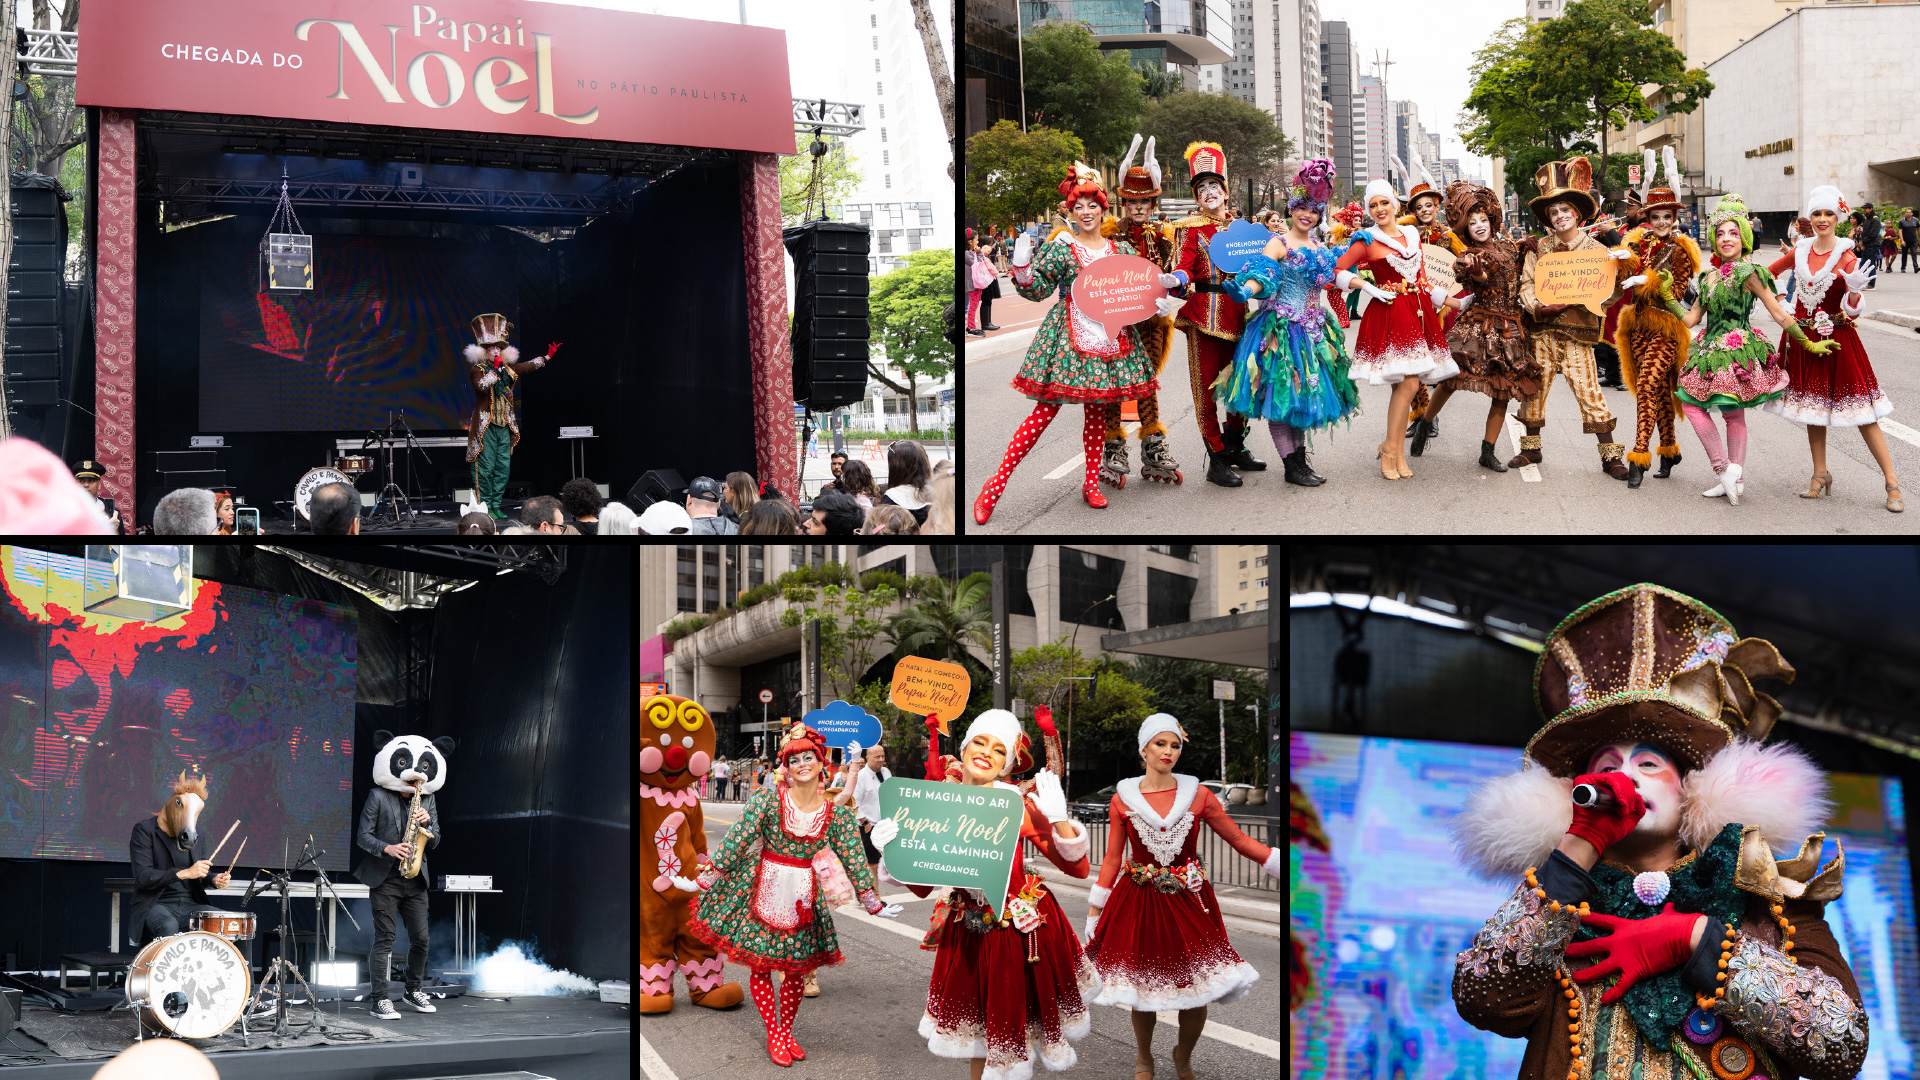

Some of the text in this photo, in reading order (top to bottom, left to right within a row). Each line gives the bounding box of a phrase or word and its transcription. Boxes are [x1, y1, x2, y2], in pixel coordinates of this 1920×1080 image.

[412, 4, 525, 52] Papai
[161, 44, 303, 69] CHEGADA DO
[577, 79, 748, 102] NO PÁTIO PAULISTA
[1226, 240, 1266, 248] #NOELNOPATIO
[1228, 248, 1264, 256] #CHEGADANO
[1084, 266, 1152, 290] Papai Noel
[1549, 268, 1602, 278] BEM-VINDO,
[1090, 284, 1151, 298] ESTÁ CHEGANDO
[1540, 274, 1608, 296] Papai Noel!
[1118, 294, 1141, 302] PÁTIO!
[1104, 305, 1144, 314] #CHEGADANOEL
[300, 474, 318, 496] CAVALO
[326, 471, 343, 482] PAND
[906, 676, 956, 692] BEM-VINDO,
[934, 670, 967, 680] COMEÇOU!
[896, 681, 962, 707] Papai Noel!
[899, 787, 1009, 809] TEM MAGIA NO AR!
[892, 806, 1009, 845] Papai Noel
[900, 838, 1003, 860] ESTÁ A CAMINHO!
[913, 861, 979, 876] #CHEGADANOEL
[154, 939, 235, 982] CAVALO E PANDA
